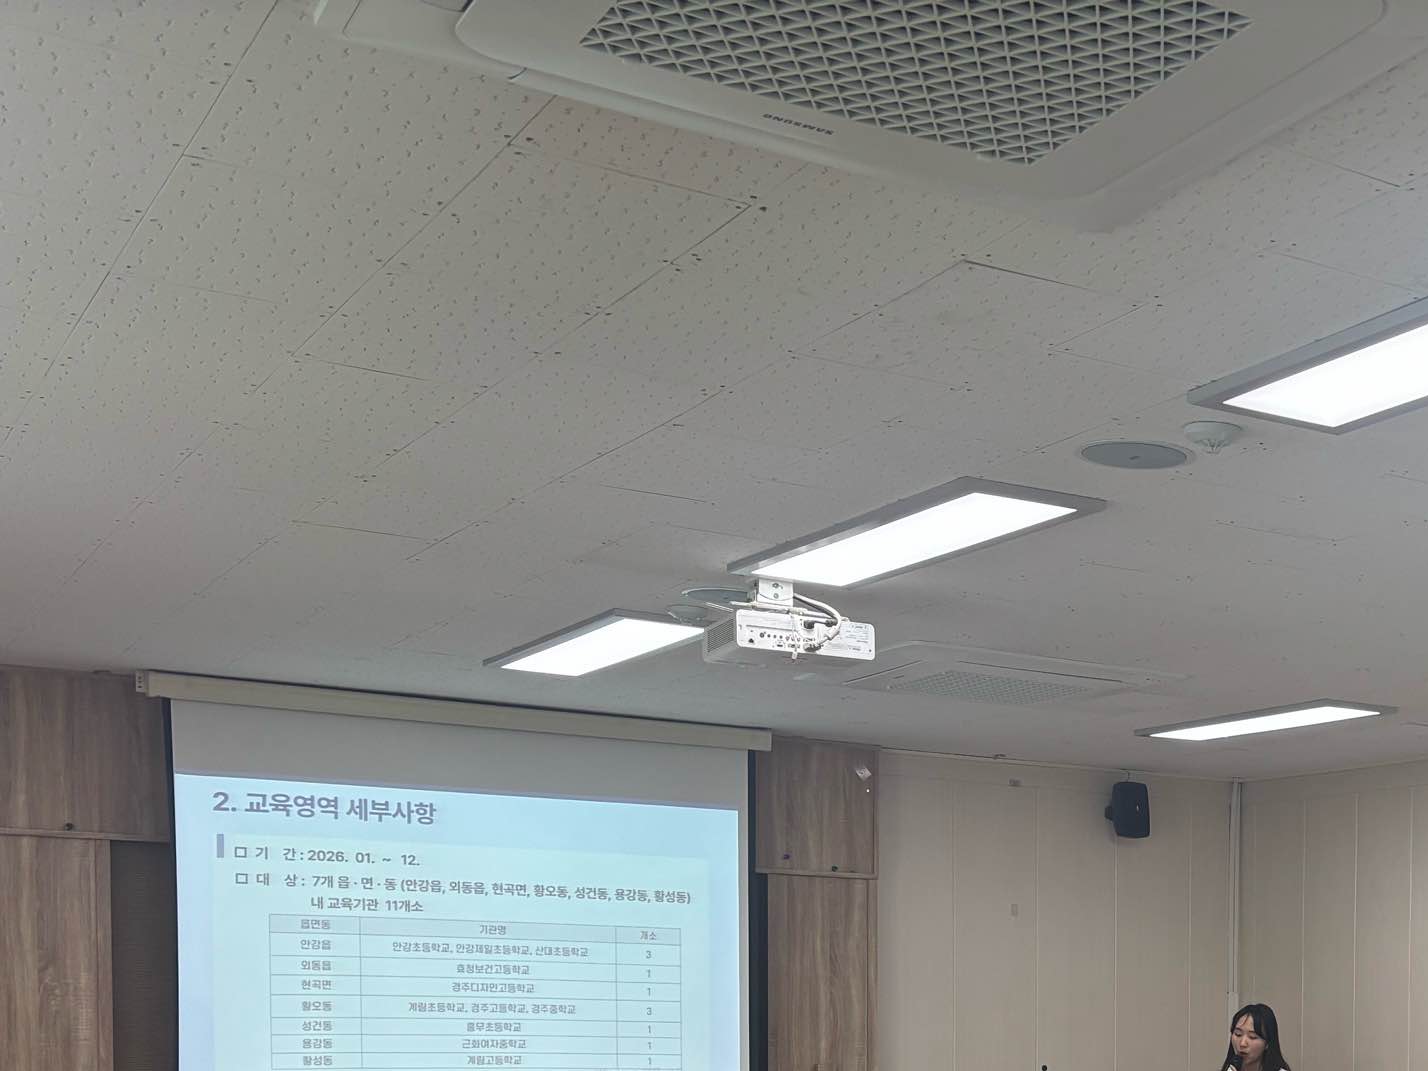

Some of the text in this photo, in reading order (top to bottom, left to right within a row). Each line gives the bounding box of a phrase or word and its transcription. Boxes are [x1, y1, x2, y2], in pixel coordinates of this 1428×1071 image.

[763, 113, 834, 135] SAMSUNG
[212, 791, 437, 825] 2. 교육영역 세부사항
[355, 852, 375, 864] 01.
[401, 854, 420, 866] 12.
[312, 875, 334, 889] 7개
[401, 879, 445, 895] (안강읍,
[449, 881, 488, 896] 외동읍,
[492, 882, 530, 898] 현곡면,
[533, 884, 571, 899] 황오동,
[575, 886, 611, 901] 성건동,
[614, 888, 651, 903] 용강동,
[654, 889, 691, 905] 황성동)
[311, 896, 424, 913] 내 교육기관 11개소
[479, 925, 507, 936] 기관명
[300, 939, 331, 951] 안강읍
